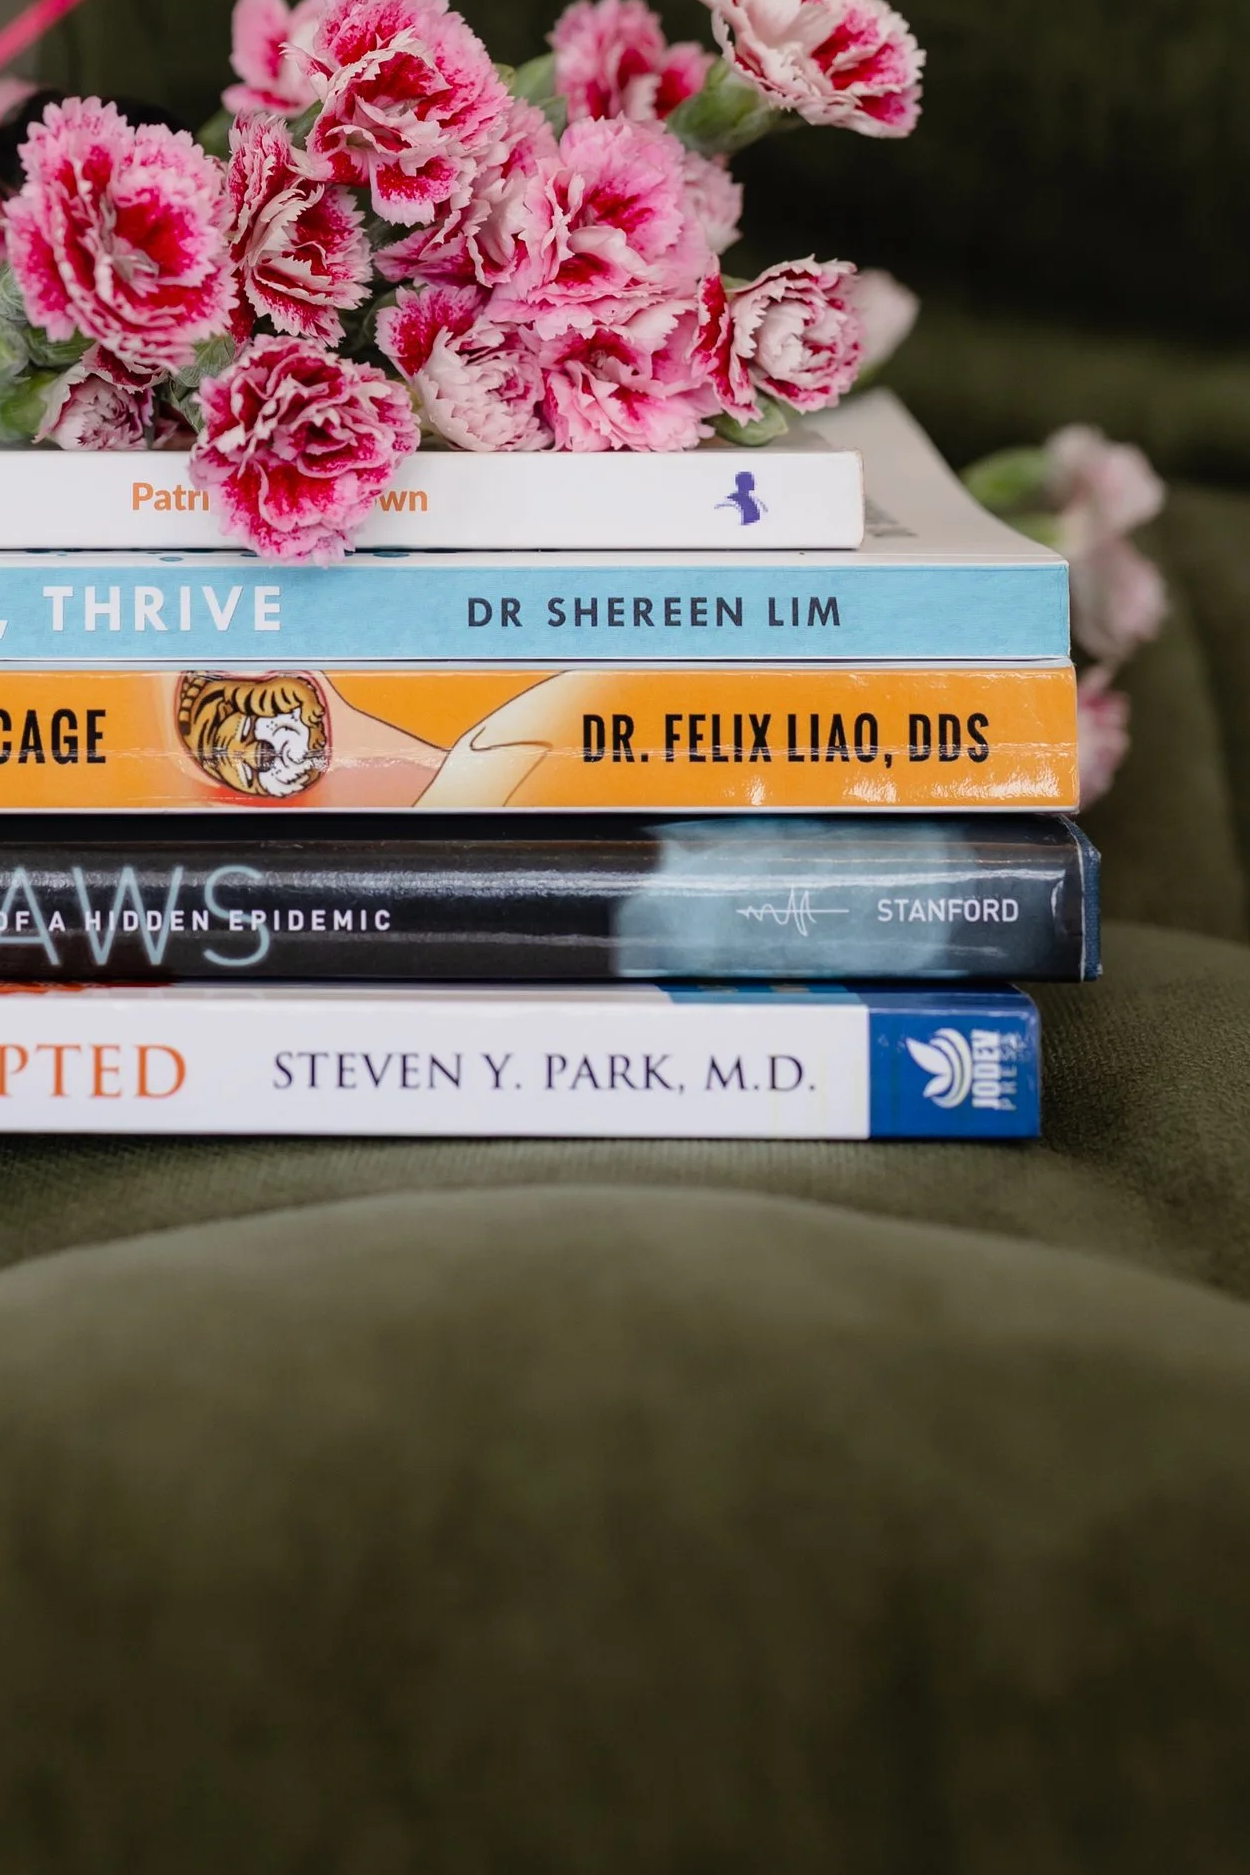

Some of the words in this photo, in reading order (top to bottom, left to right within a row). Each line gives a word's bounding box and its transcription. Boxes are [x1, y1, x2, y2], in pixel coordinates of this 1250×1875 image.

[132, 482, 210, 511] Patri
[43, 585, 281, 632] THRIVE
[467, 596, 523, 628] DR
[547, 596, 743, 628] SHEREEN
[768, 596, 841, 627] LIM
[582, 713, 649, 763] DR.
[664, 713, 772, 763] FELIX
[787, 712, 893, 769] LIAO,
[908, 712, 990, 764] DDS
[48, 910, 67, 933] A
[83, 909, 211, 932] HIDDEN
[228, 908, 393, 931] EPIDEMIC
[877, 898, 1019, 922] STANFORD
[272, 1051, 463, 1090] STEVEN
[482, 1052, 524, 1091] Y.
[545, 1053, 686, 1096] PARK,
[705, 1054, 815, 1093] M.D.
[970, 1028, 1001, 1109] JODEV
